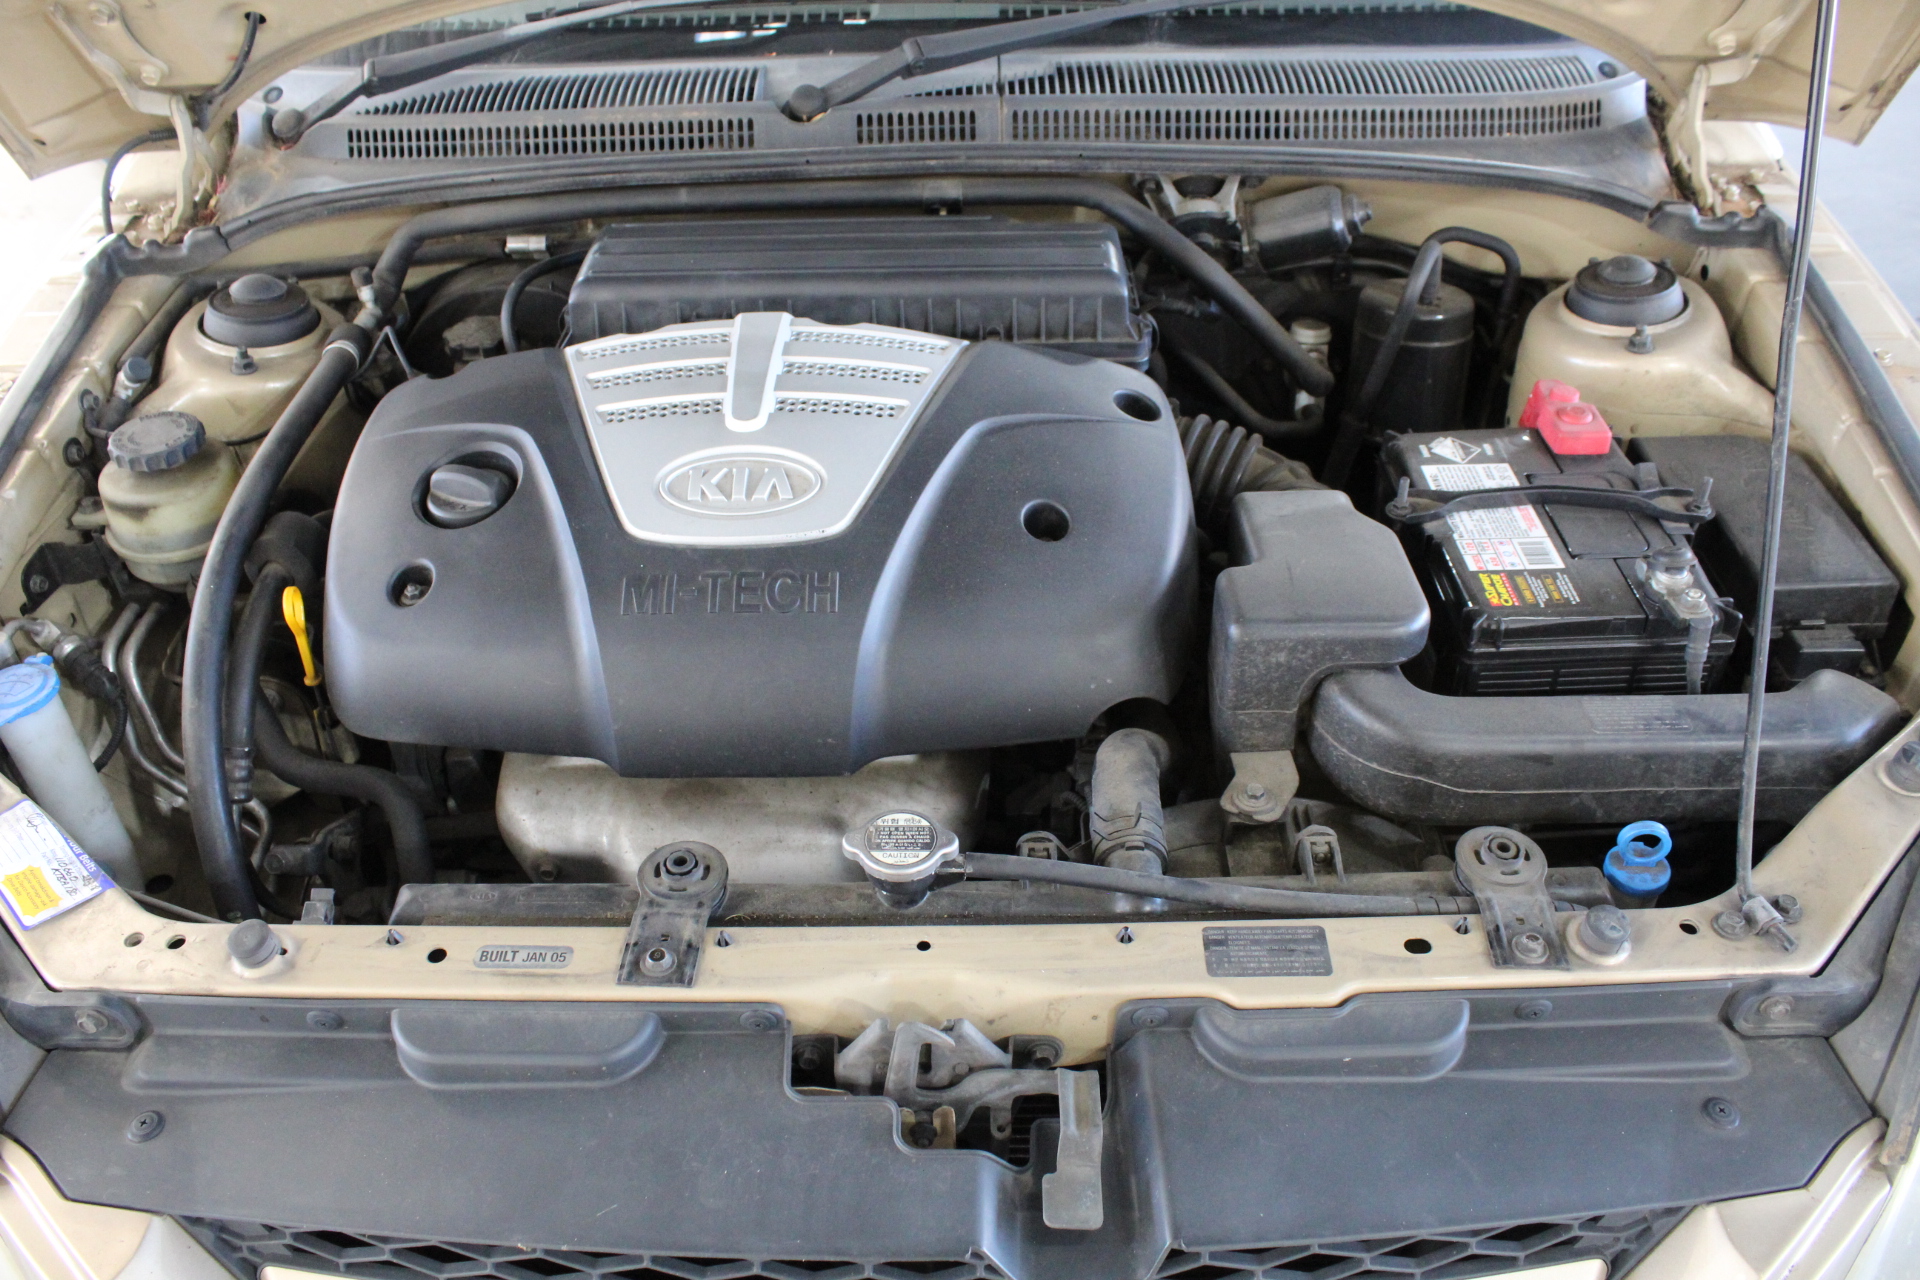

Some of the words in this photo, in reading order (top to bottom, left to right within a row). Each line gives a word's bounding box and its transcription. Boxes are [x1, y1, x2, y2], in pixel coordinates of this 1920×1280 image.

[687, 466, 794, 502] KIA
[620, 570, 840, 616] MI-TECH
[1477, 573, 1499, 599] SUPER
[1490, 574, 1513, 606] CHARGE
[79, 854, 97, 873] Belts
[479, 950, 519, 962] BUILT
[522, 952, 548, 963] JAN
[550, 952, 568, 963] 05
